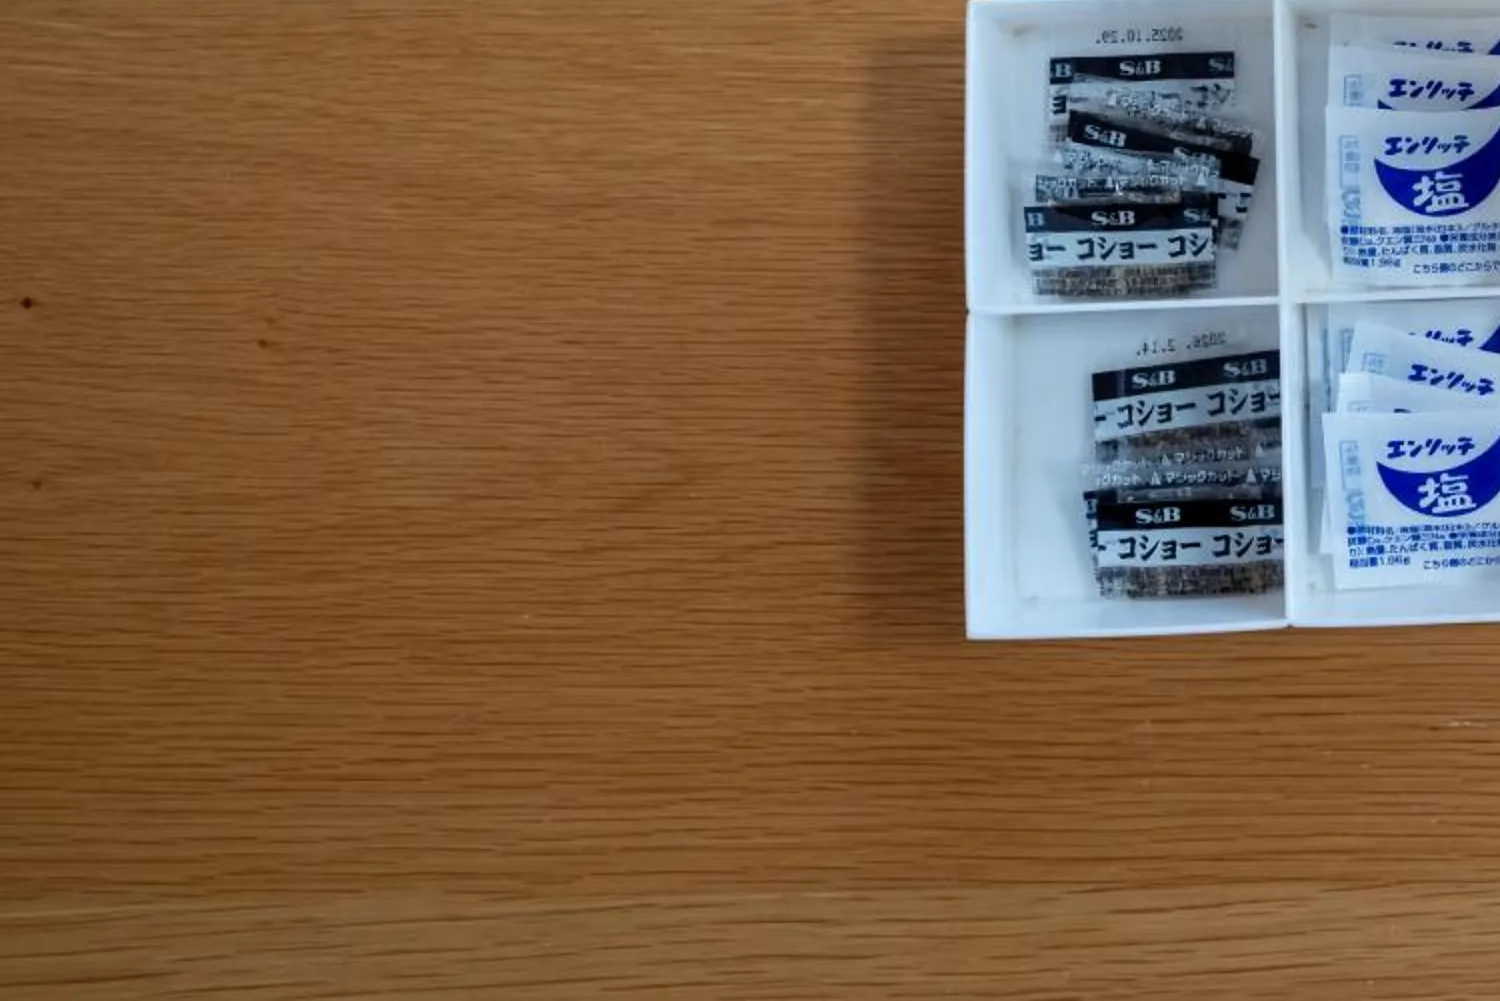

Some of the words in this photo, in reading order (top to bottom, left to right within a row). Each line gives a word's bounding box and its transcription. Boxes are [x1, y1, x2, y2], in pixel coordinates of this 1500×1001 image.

[1119, 59, 1161, 76] S&B
[1412, 170, 1469, 213] 塩
[1091, 209, 1136, 226] S&B
[1077, 236, 1157, 260] コショー
[1131, 368, 1175, 389] S&B
[1222, 357, 1268, 379] S&B
[1116, 400, 1197, 429] コショー
[1417, 471, 1477, 513] 塩
[1135, 506, 1181, 523] S&B
[1229, 504, 1275, 522] S&B
[1116, 534, 1201, 561] コショー
